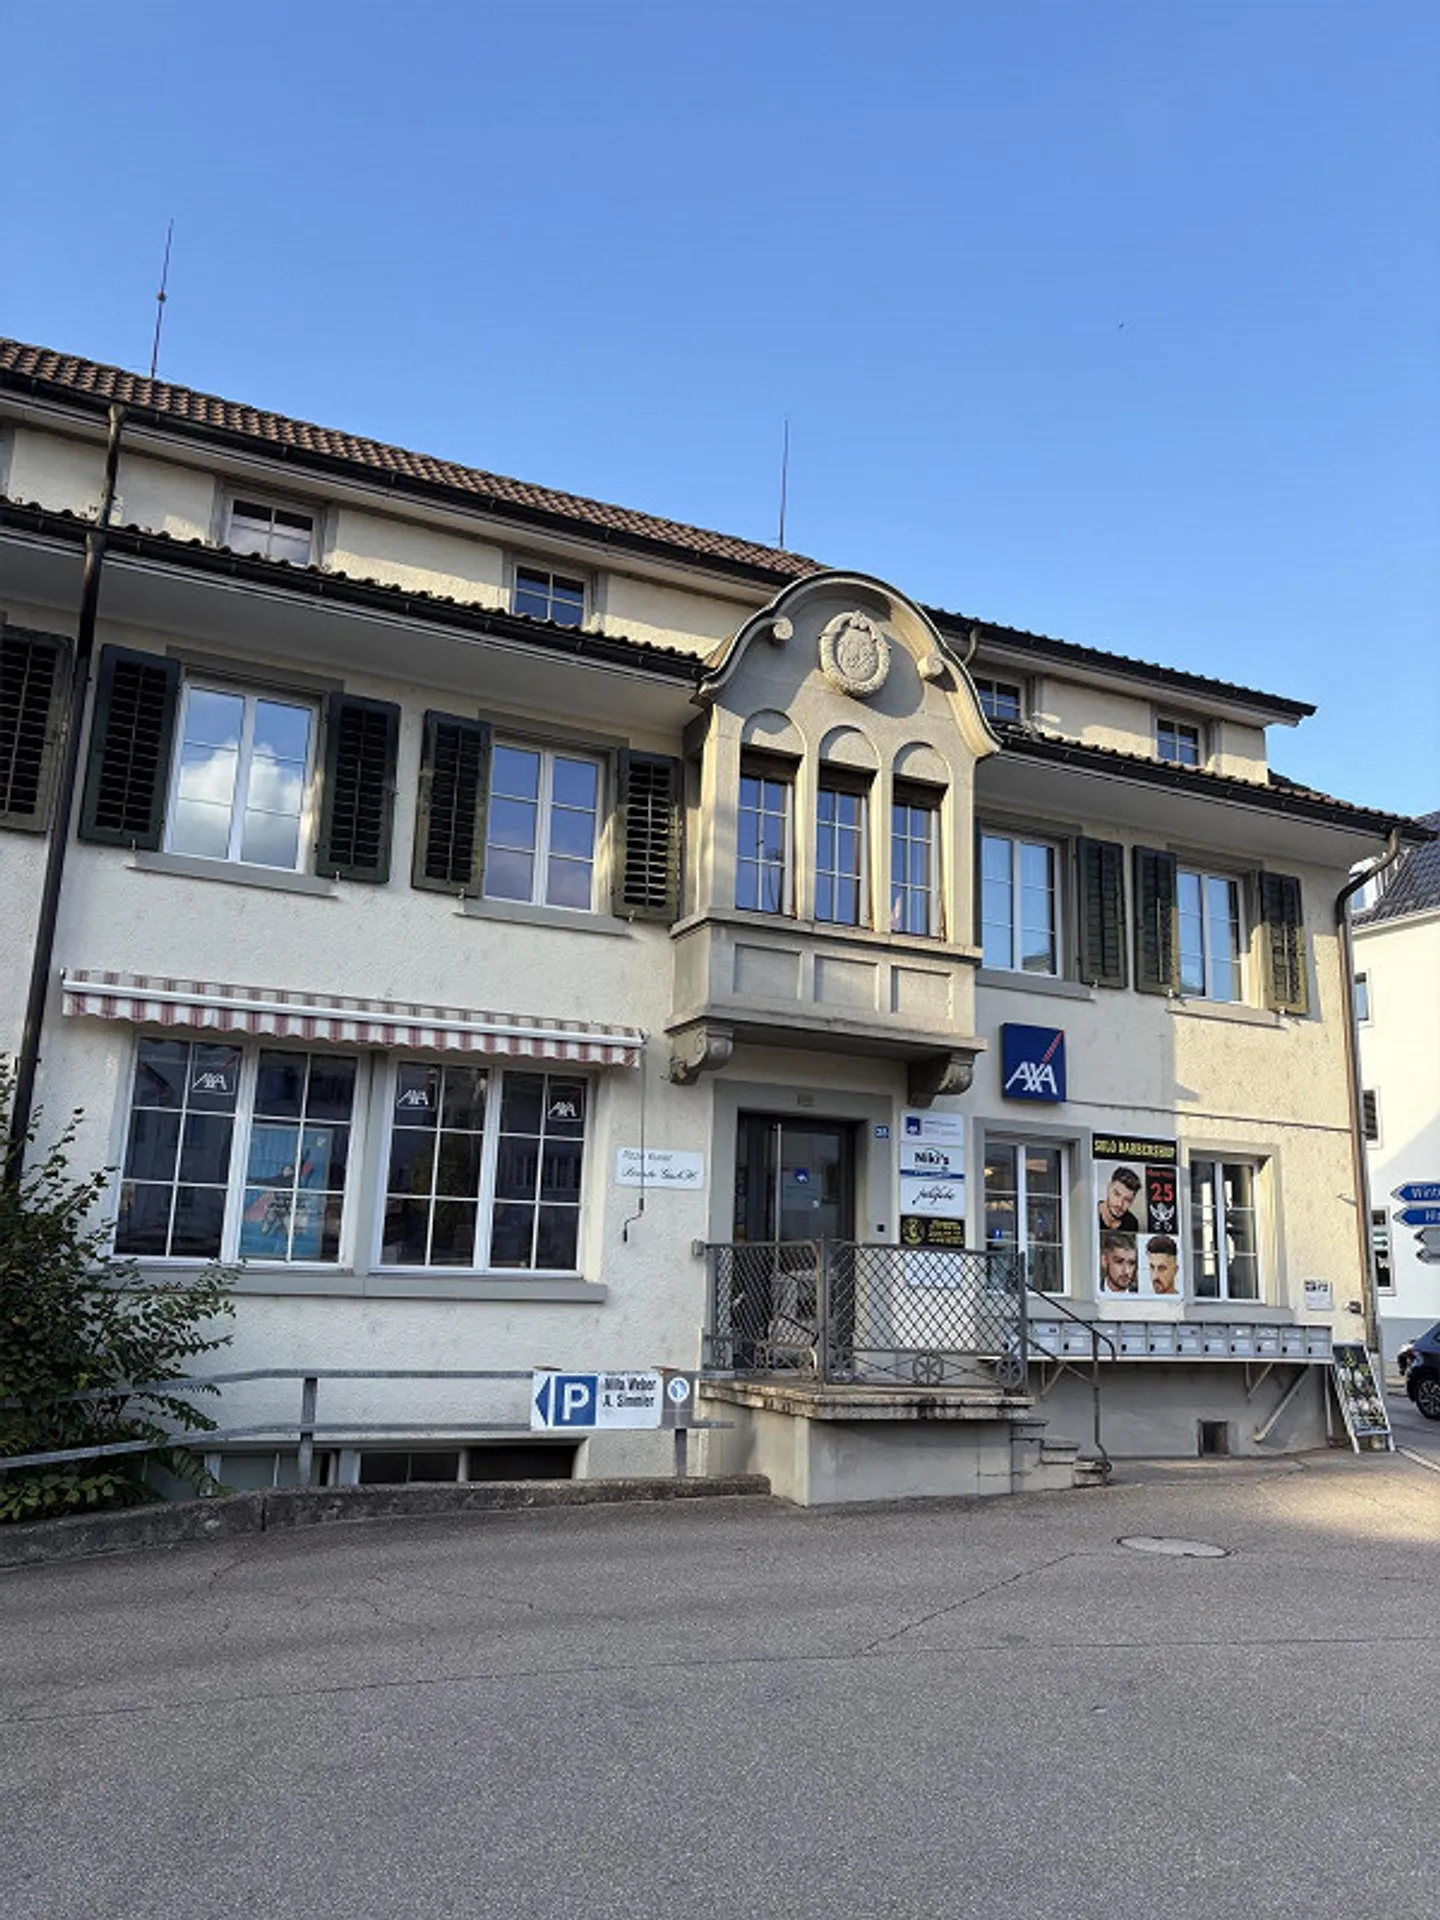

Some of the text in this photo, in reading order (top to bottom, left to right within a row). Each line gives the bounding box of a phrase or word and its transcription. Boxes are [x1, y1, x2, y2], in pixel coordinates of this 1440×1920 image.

[192, 1072, 227, 1090] AXA
[1005, 1061, 1058, 1095] AXA
[398, 1089, 429, 1106] AXA
[548, 1101, 577, 1118] AXA
[1150, 1182, 1174, 1202] 25
[561, 1382, 590, 1421] P
